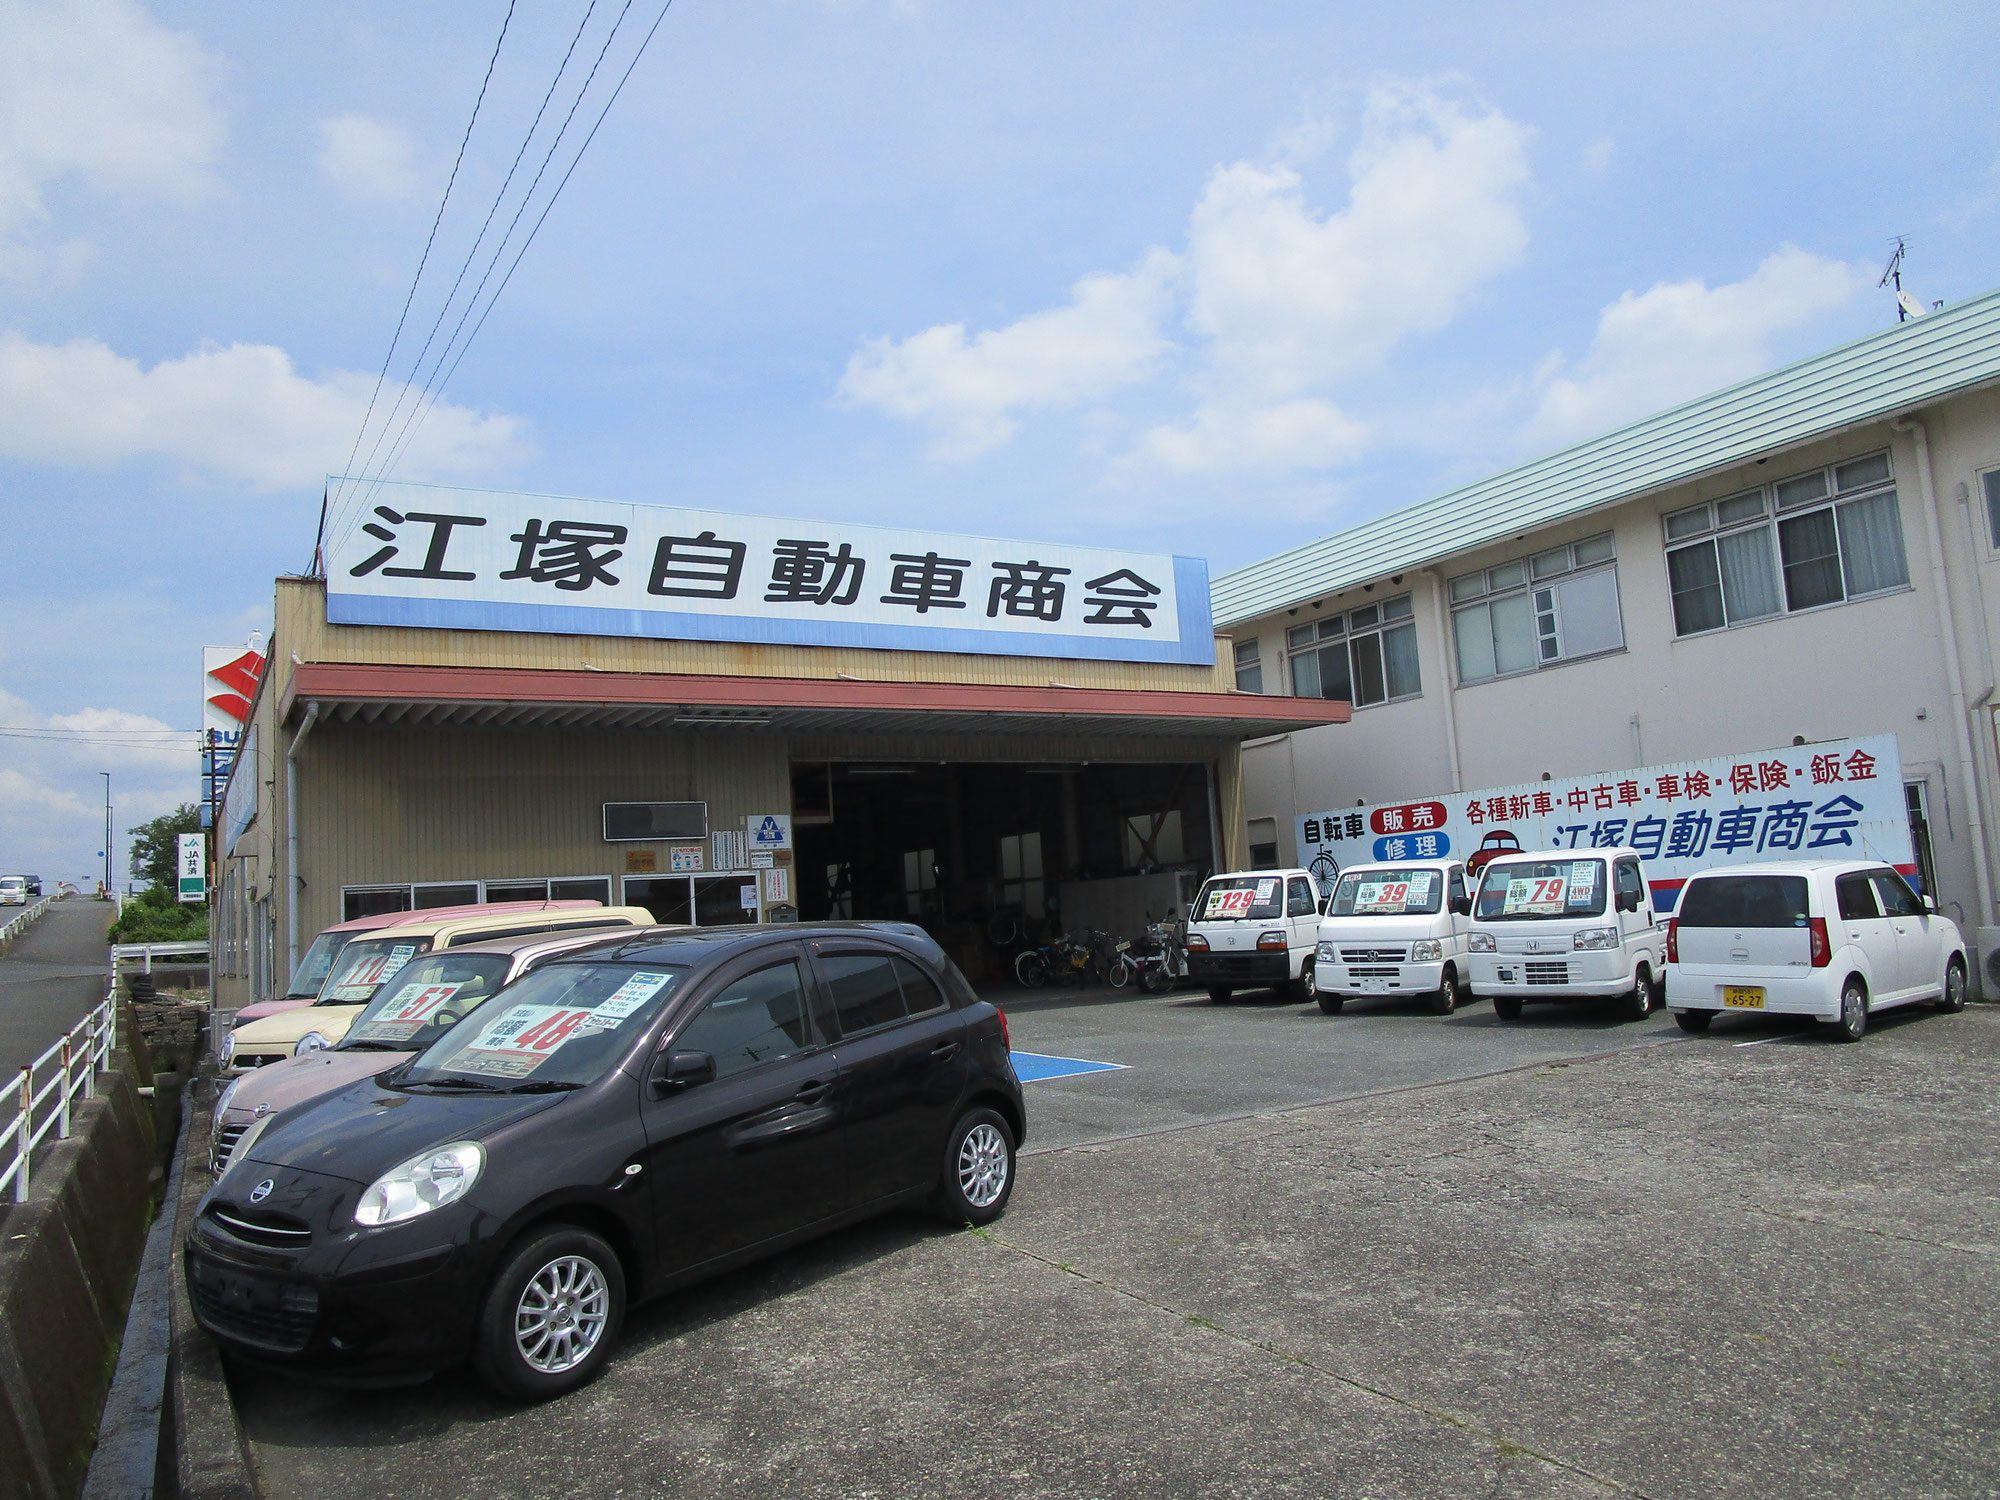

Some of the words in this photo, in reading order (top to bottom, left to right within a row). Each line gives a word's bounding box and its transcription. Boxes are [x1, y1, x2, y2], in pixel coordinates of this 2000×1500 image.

[350, 505, 1161, 629] 江塚自動車商会
[207, 730, 243, 743] SU
[1303, 813, 1365, 844] 自転車
[1382, 805, 1435, 832] 販売
[1384, 834, 1438, 861] 修理
[1222, 891, 1255, 909] 129
[1378, 884, 1408, 902] 39
[1530, 879, 1563, 901] 79
[1571, 886, 1591, 896] 4WD
[398, 987, 457, 1019] 57
[1732, 995, 1761, 1007] 65-27
[513, 1010, 592, 1051] 48
